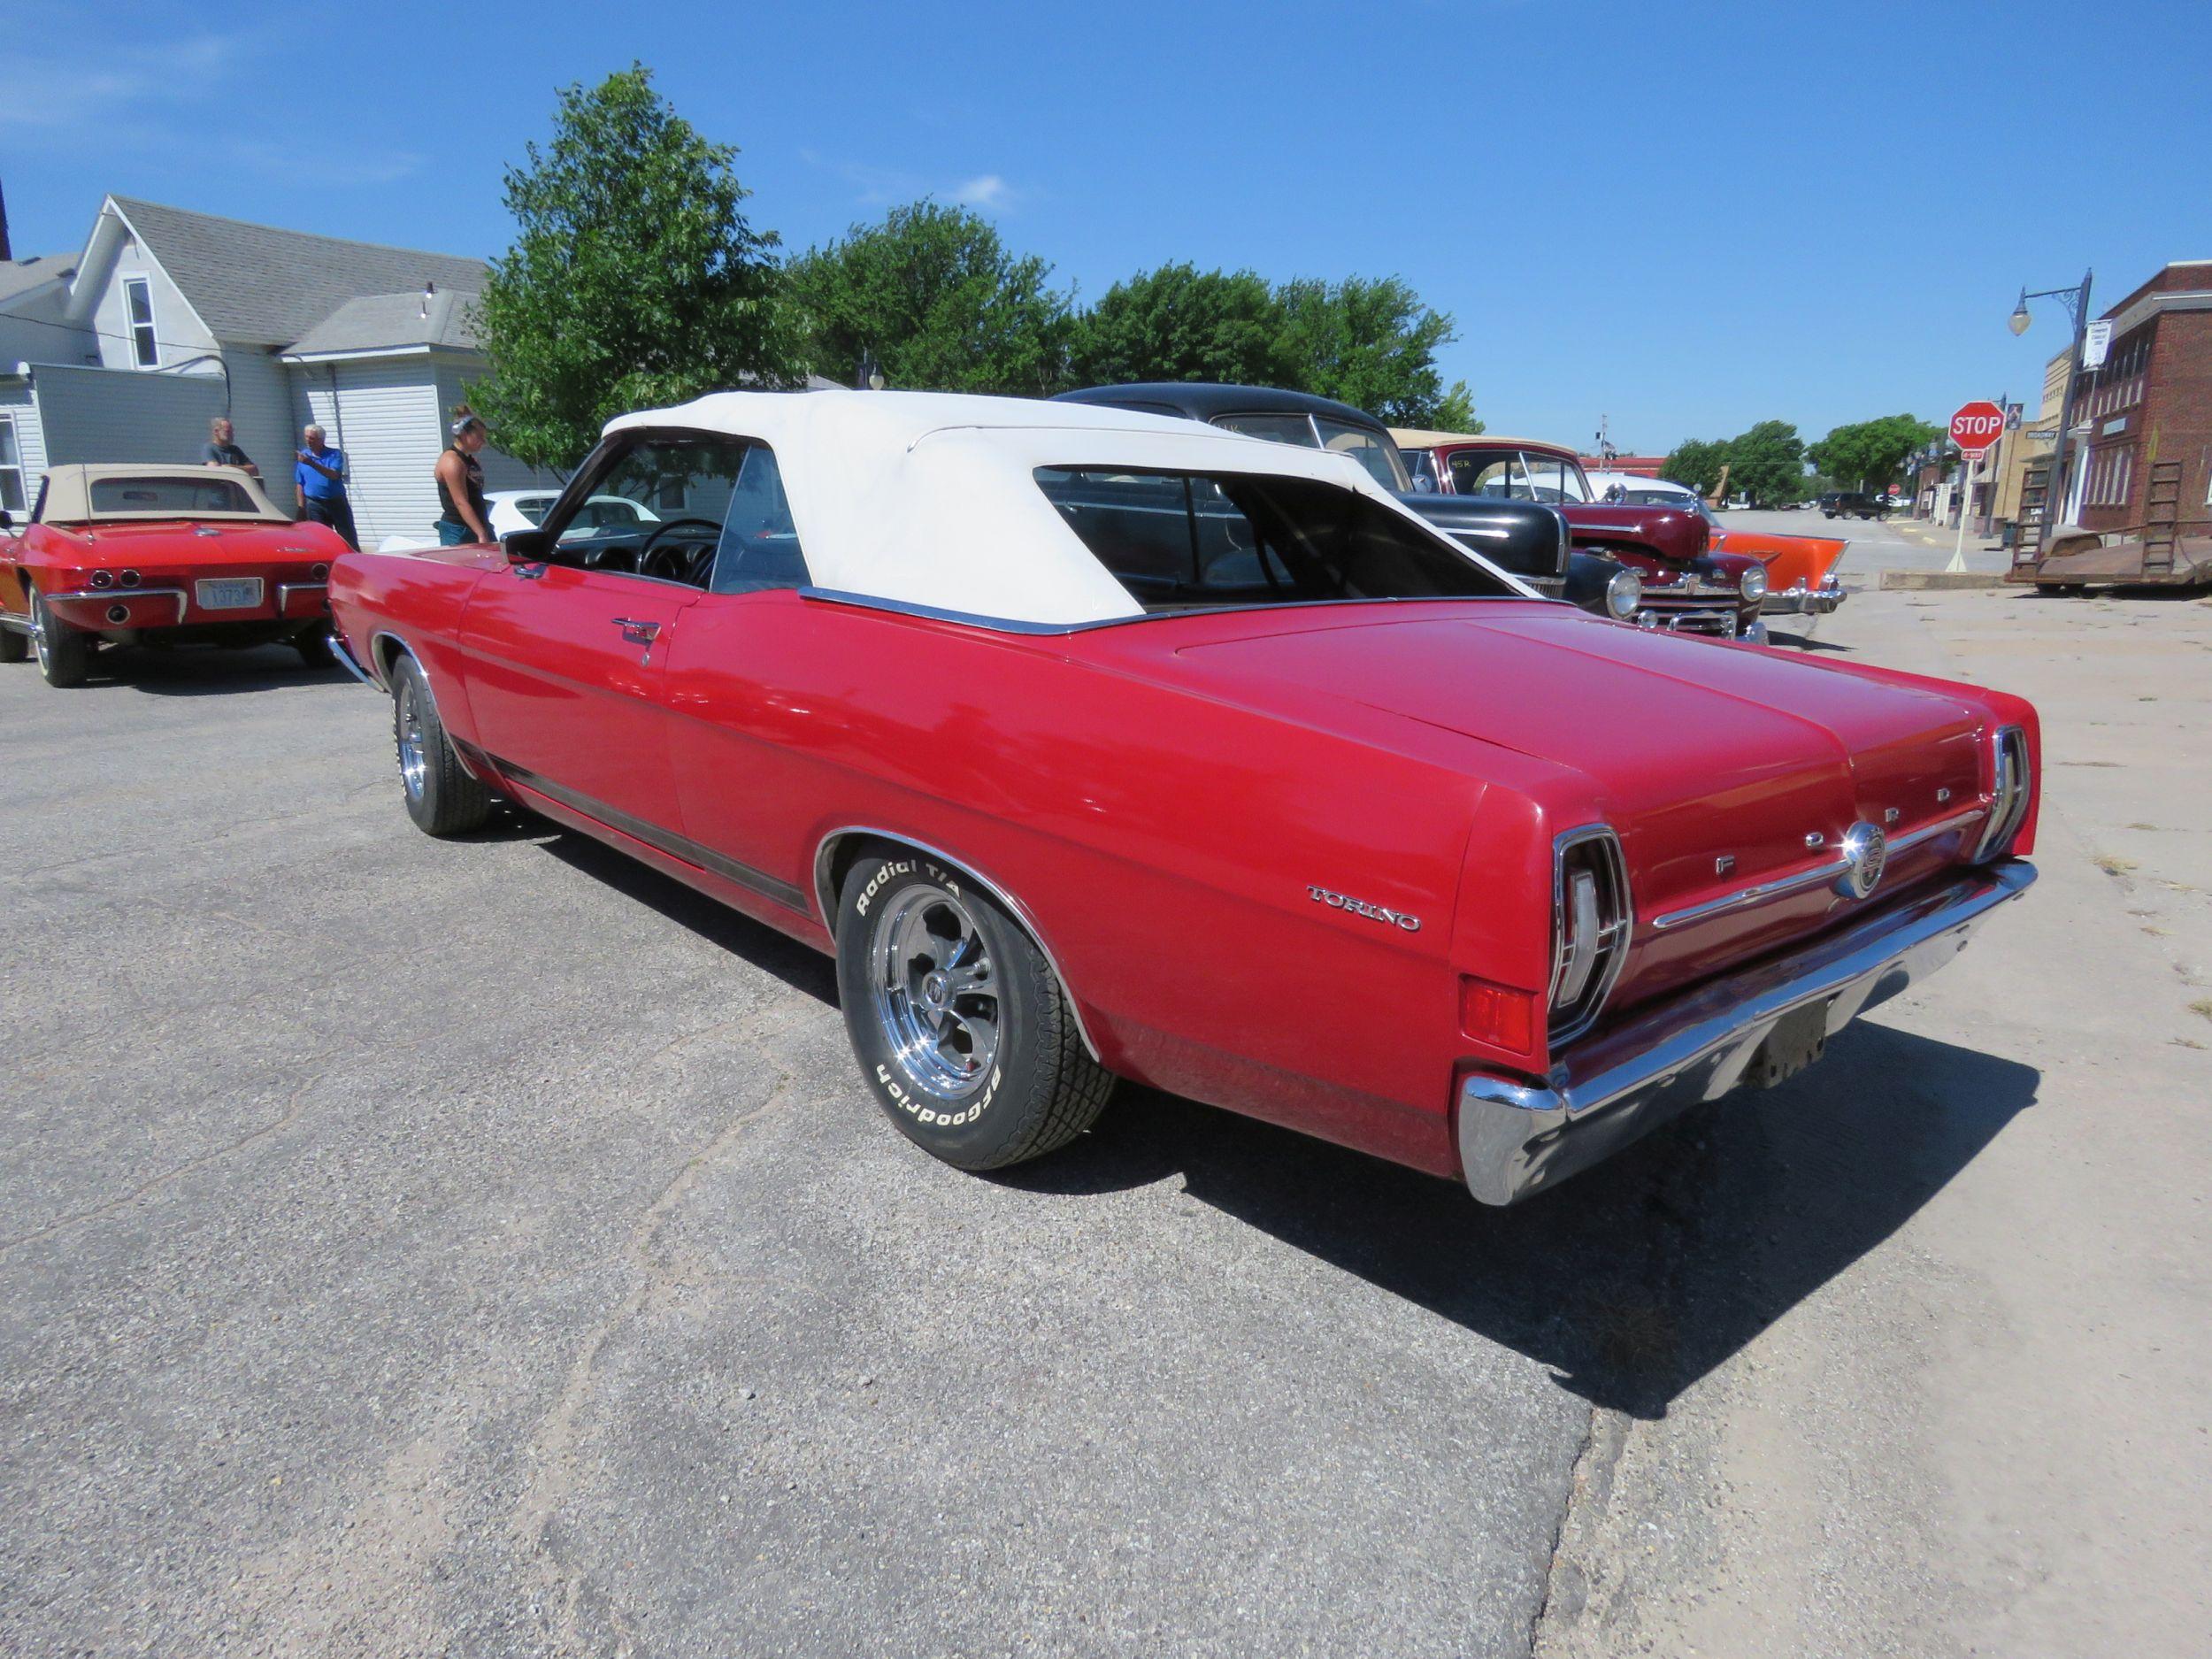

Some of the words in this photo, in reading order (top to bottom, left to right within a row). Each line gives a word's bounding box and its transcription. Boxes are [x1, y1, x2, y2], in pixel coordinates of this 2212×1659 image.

[1953, 415, 2001, 434] STOP
[856, 860, 917, 917] Radial
[1306, 885, 1422, 932] TORINO
[877, 1064, 1002, 1126] BFGoodrich
